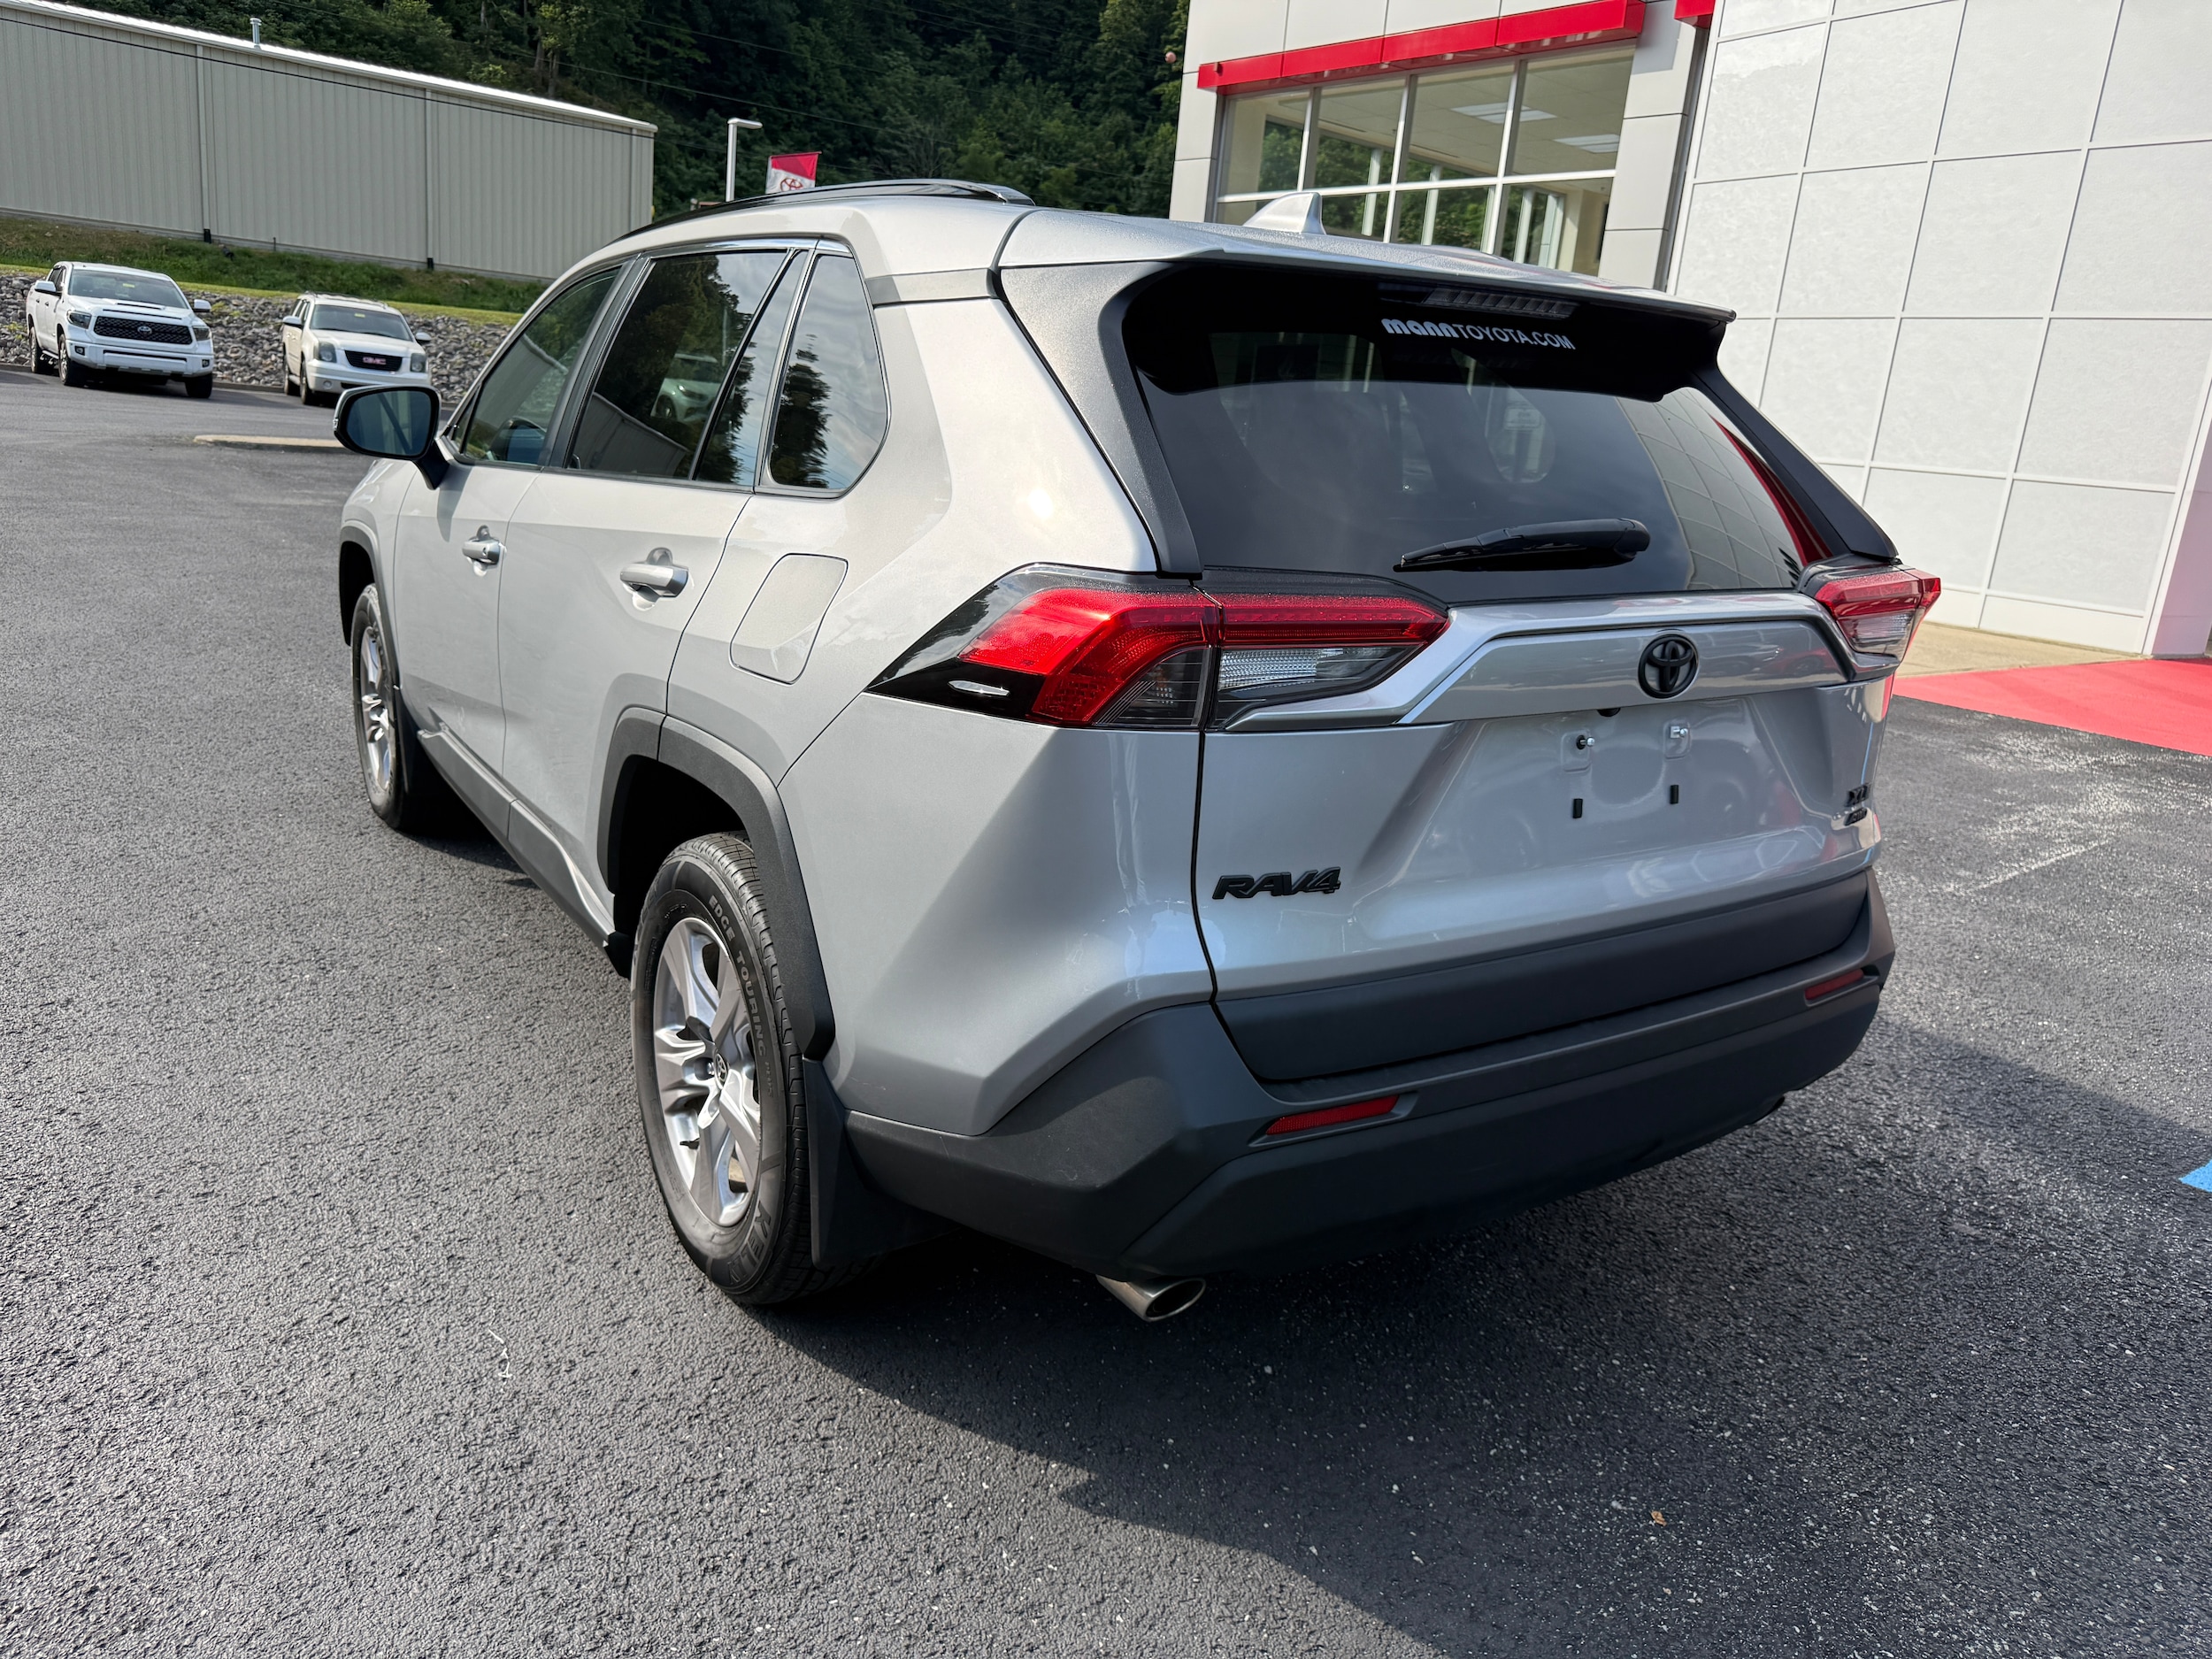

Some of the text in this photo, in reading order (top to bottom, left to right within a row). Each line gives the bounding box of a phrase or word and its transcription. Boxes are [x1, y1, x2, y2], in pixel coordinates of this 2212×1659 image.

[1212, 866, 1341, 900] RAV4
[708, 895, 735, 941] EDGE
[735, 950, 766, 1056] TOURING
[727, 1200, 772, 1285] KELLY
